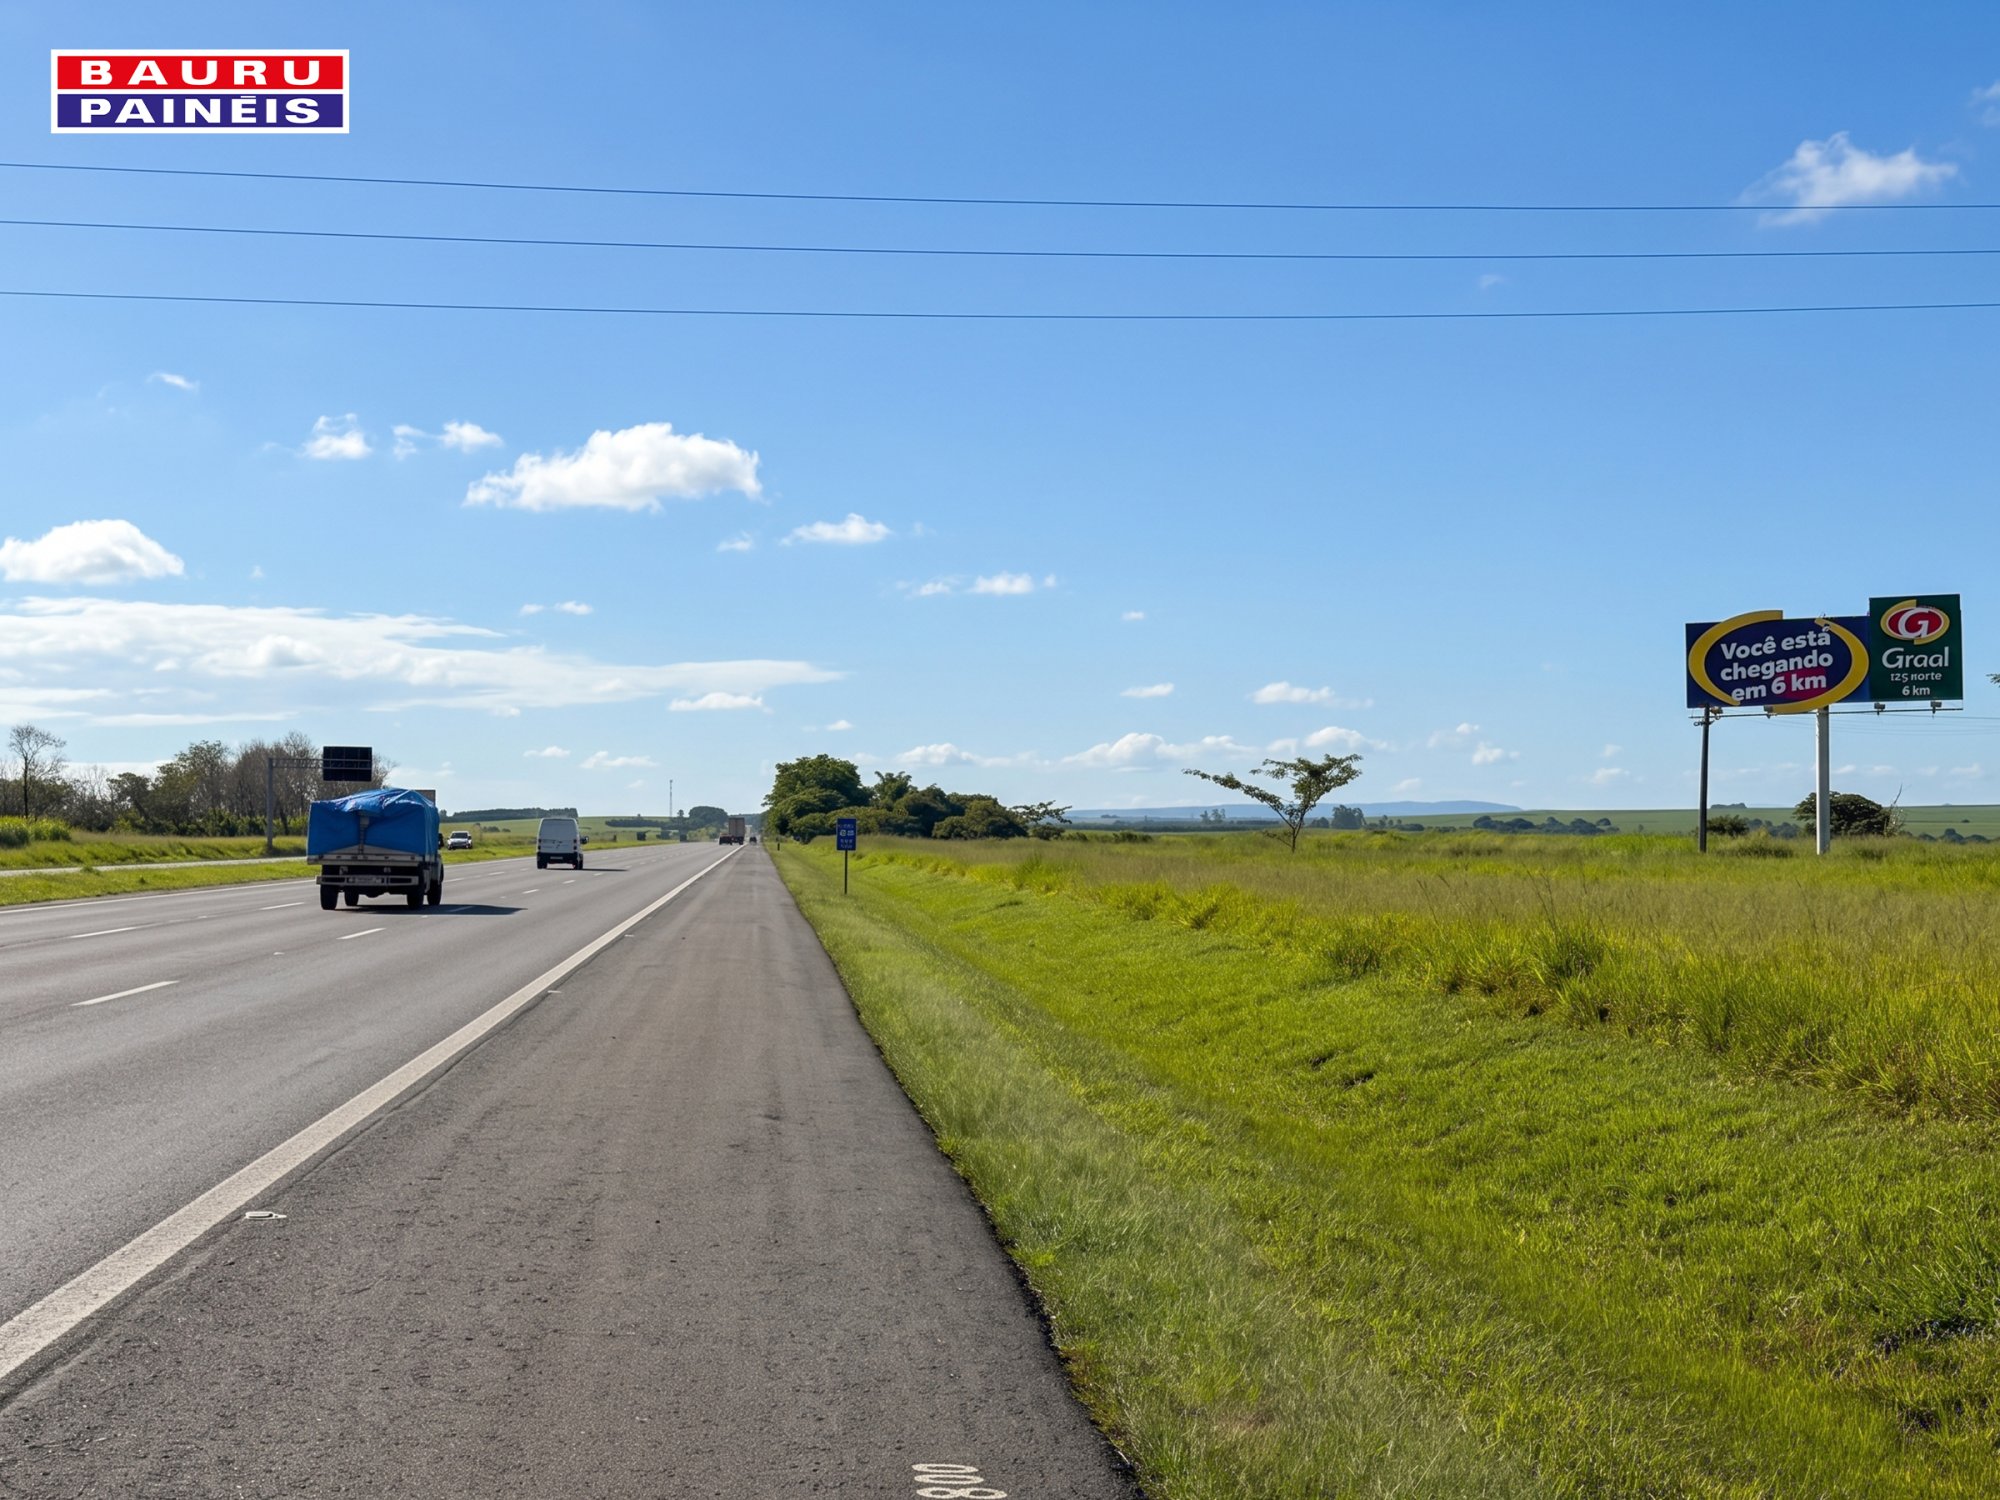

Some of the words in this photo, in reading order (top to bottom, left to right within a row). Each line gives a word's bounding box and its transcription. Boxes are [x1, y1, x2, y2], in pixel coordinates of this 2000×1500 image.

[1720, 635, 1777, 660] Você
[1781, 625, 1831, 651] está
[1720, 649, 1834, 681] chegando
[1881, 646, 1949, 669] Graal
[1731, 684, 1767, 701] em
[1771, 676, 1786, 695] 6
[1791, 674, 1827, 692] km
[1901, 685, 1910, 696] 6
[1912, 685, 1931, 696] km
